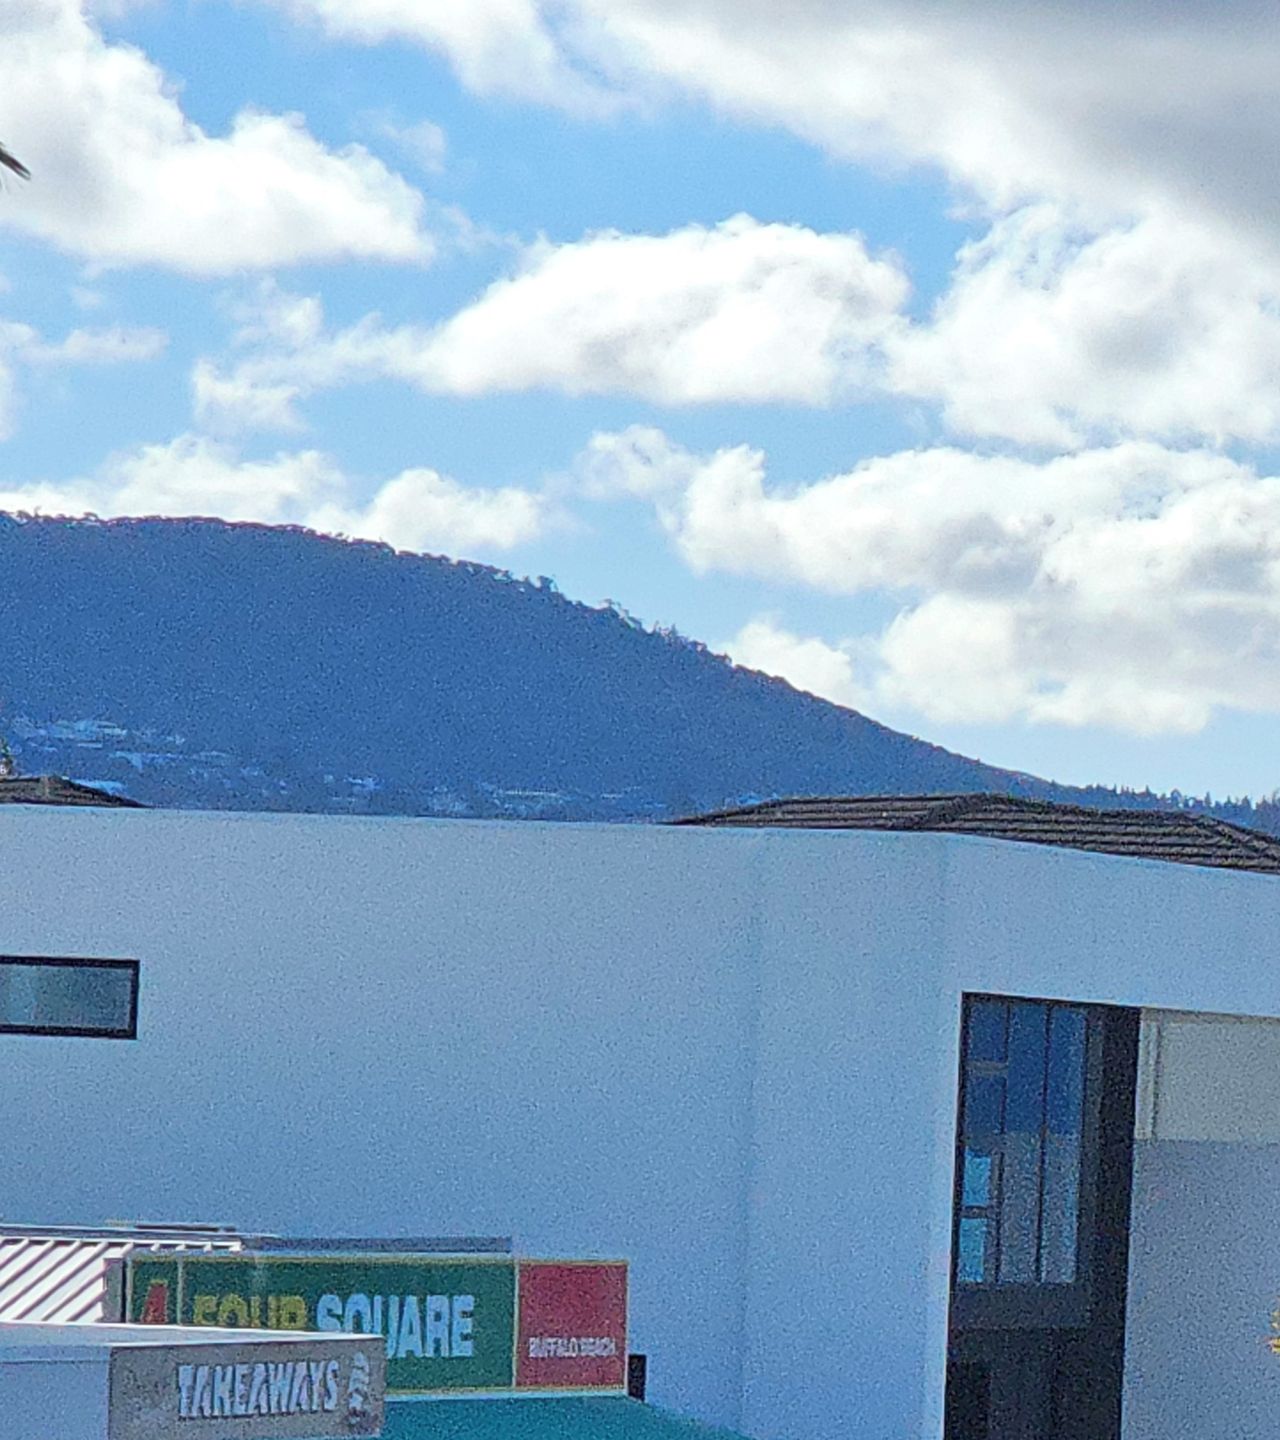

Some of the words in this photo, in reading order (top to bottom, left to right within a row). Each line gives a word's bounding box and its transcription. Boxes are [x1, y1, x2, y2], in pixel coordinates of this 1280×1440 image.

[193, 1294, 306, 1329] FOUR
[316, 1293, 474, 1358] SQUARE
[177, 1360, 340, 1418] TAKEAWAYS
